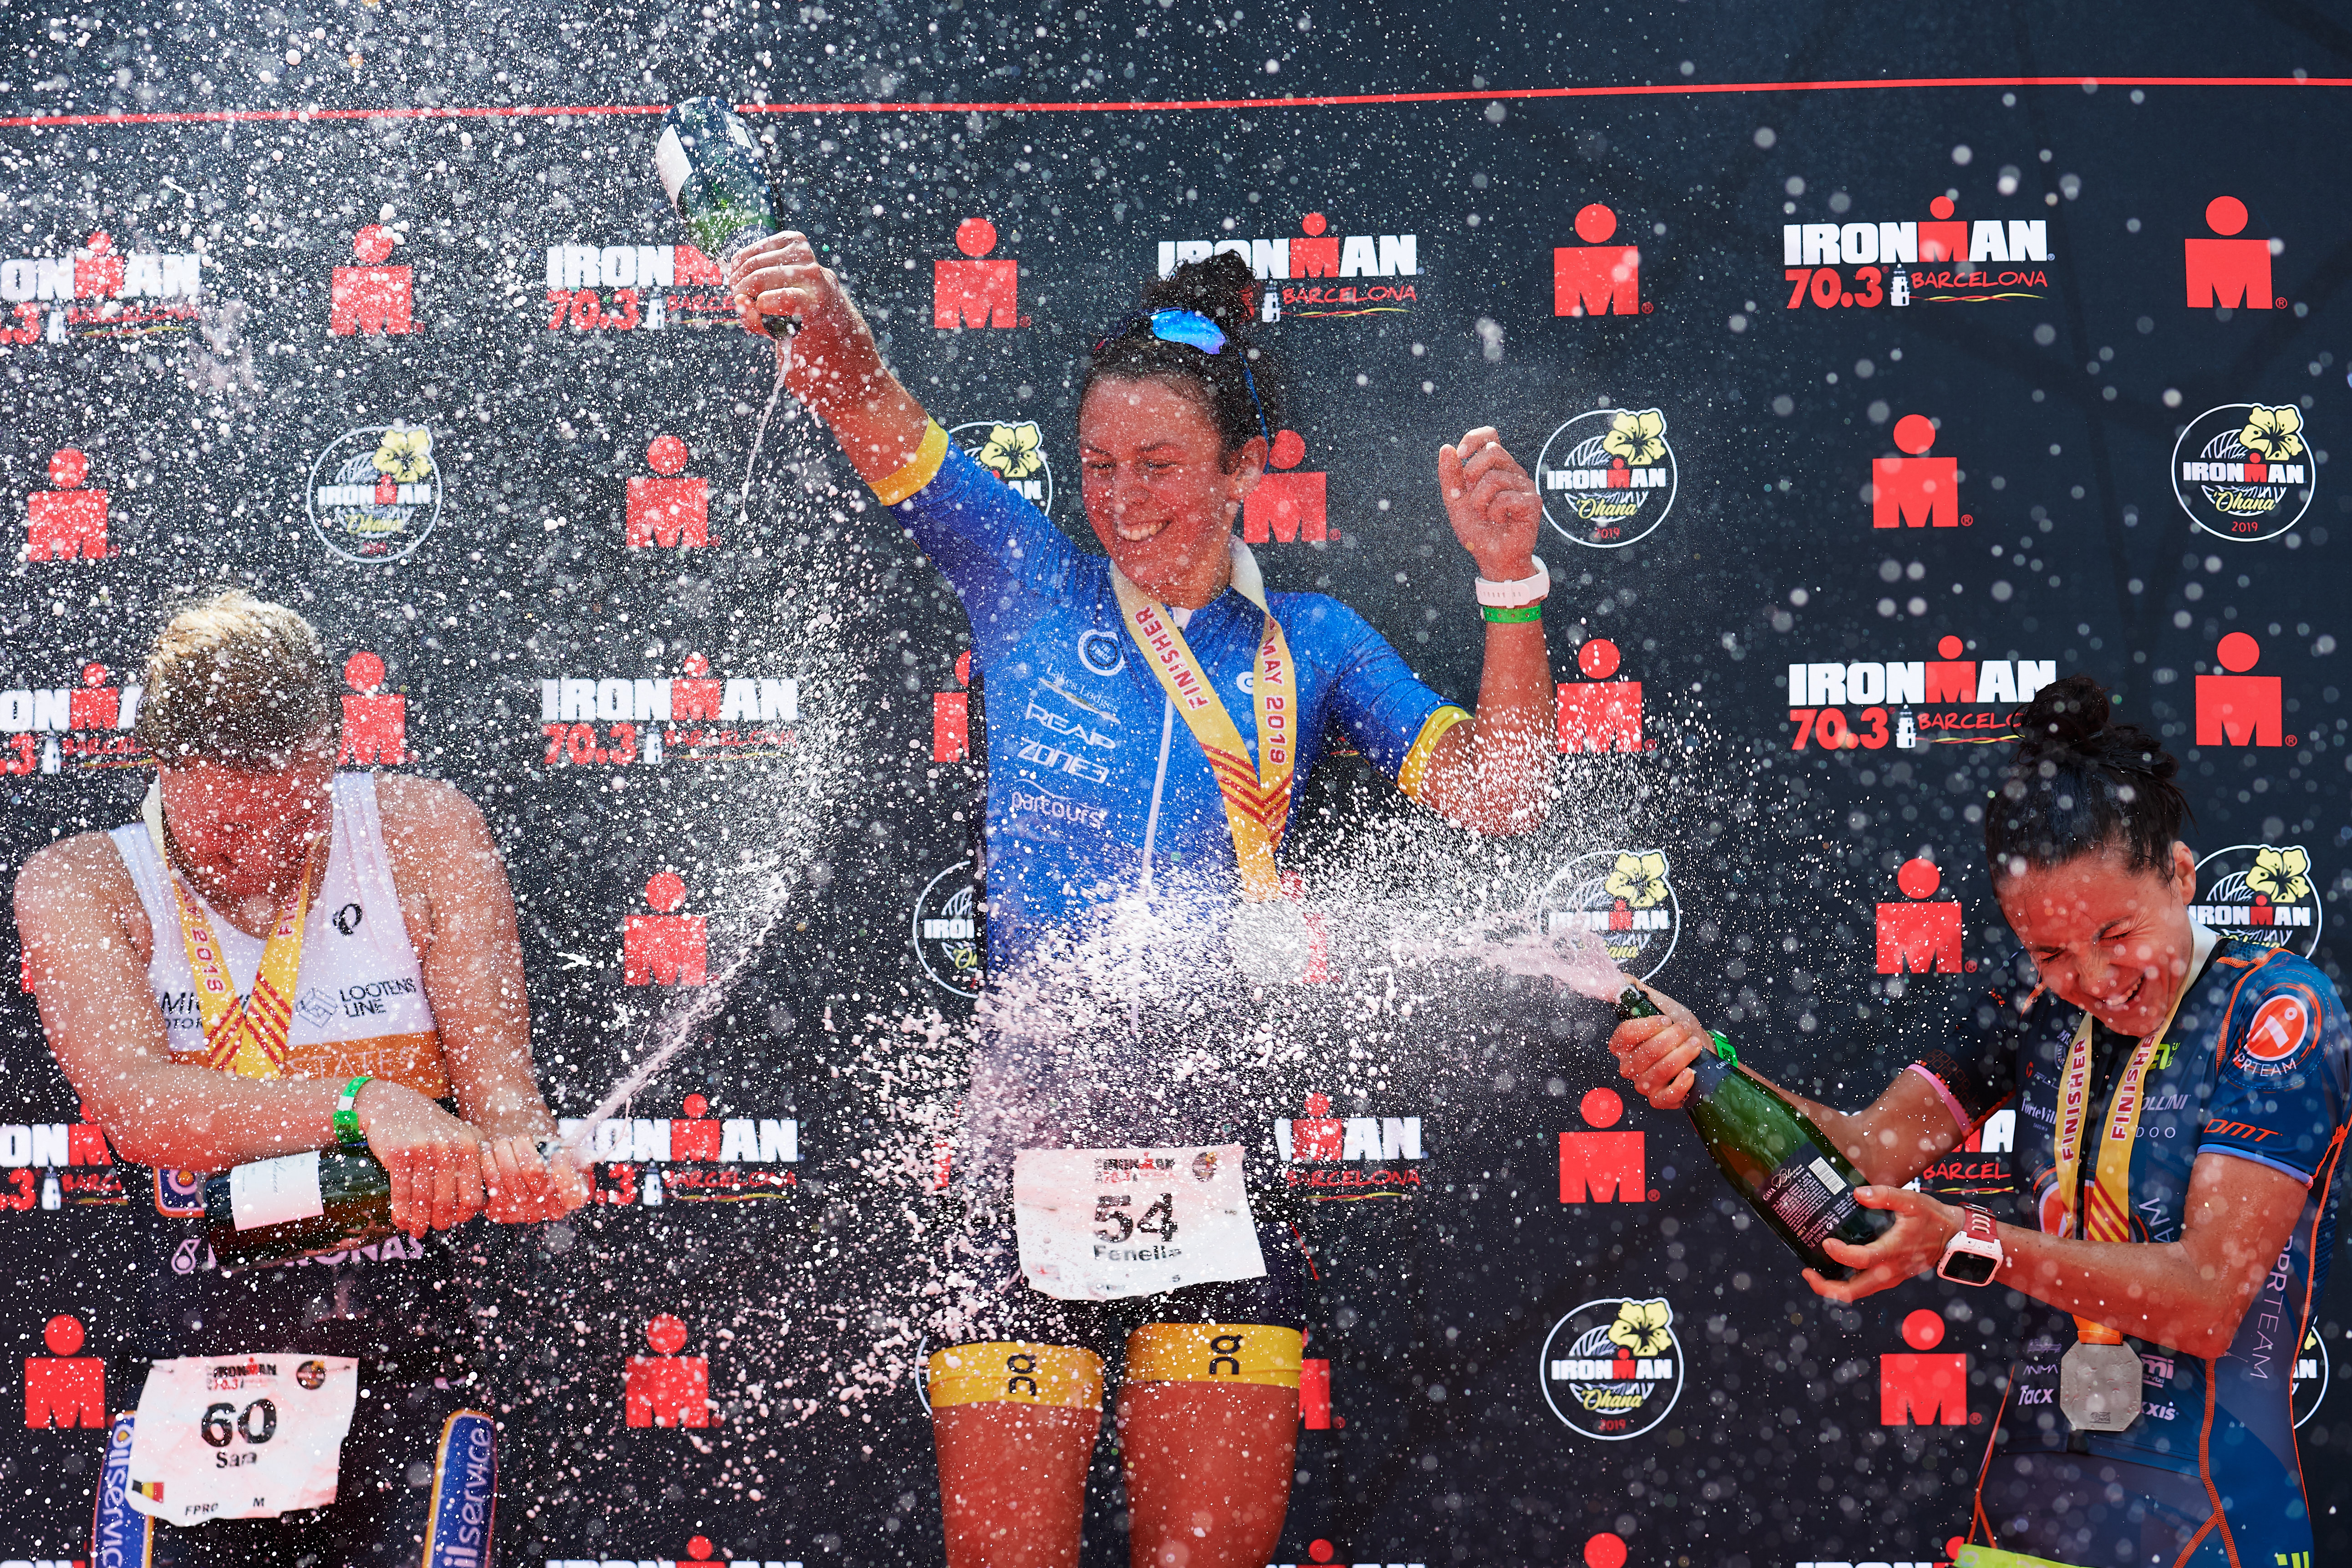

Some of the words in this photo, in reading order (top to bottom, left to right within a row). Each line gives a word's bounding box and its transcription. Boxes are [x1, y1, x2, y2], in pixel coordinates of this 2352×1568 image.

[1783, 220, 2047, 265] IRONMAN
[547, 245, 728, 286] IRONM
[1282, 284, 1417, 304] BARCELONA
[1784, 267, 1883, 309] 70.3
[1912, 270, 2048, 289] BARCELONA
[547, 289, 639, 330] 70.3
[1547, 468, 1666, 490] IRONMAN
[2183, 462, 2304, 483] IRONMAN
[317, 484, 431, 506] IRONMAN
[1594, 527, 1620, 539] 2019
[2231, 521, 2258, 533] 2019
[1135, 605, 1210, 710] FINISHER
[542, 679, 798, 721] IRONMAN
[1789, 660, 2057, 705] IRONMAN
[543, 723, 637, 765] 70.3
[1265, 696, 1287, 766] 2019
[1790, 706, 1889, 750] 70.3
[191, 927, 226, 994] 2019
[340, 977, 416, 1002] LOOTENS
[344, 999, 386, 1018] LINE
[2062, 1036, 2087, 1162] FINISHER
[2110, 1028, 2161, 1141] FINISHE
[2203, 1118, 2280, 1142] DMT
[664, 1170, 797, 1188] BARCELONA
[1286, 1169, 1421, 1187] BARCELONA
[1762, 1187, 1777, 1201] CAVA
[1093, 1192, 1179, 1243] 54
[1551, 1359, 1672, 1380] IRONMAN
[2018, 1385, 2055, 1406] Tacx
[201, 1398, 277, 1447] 60
